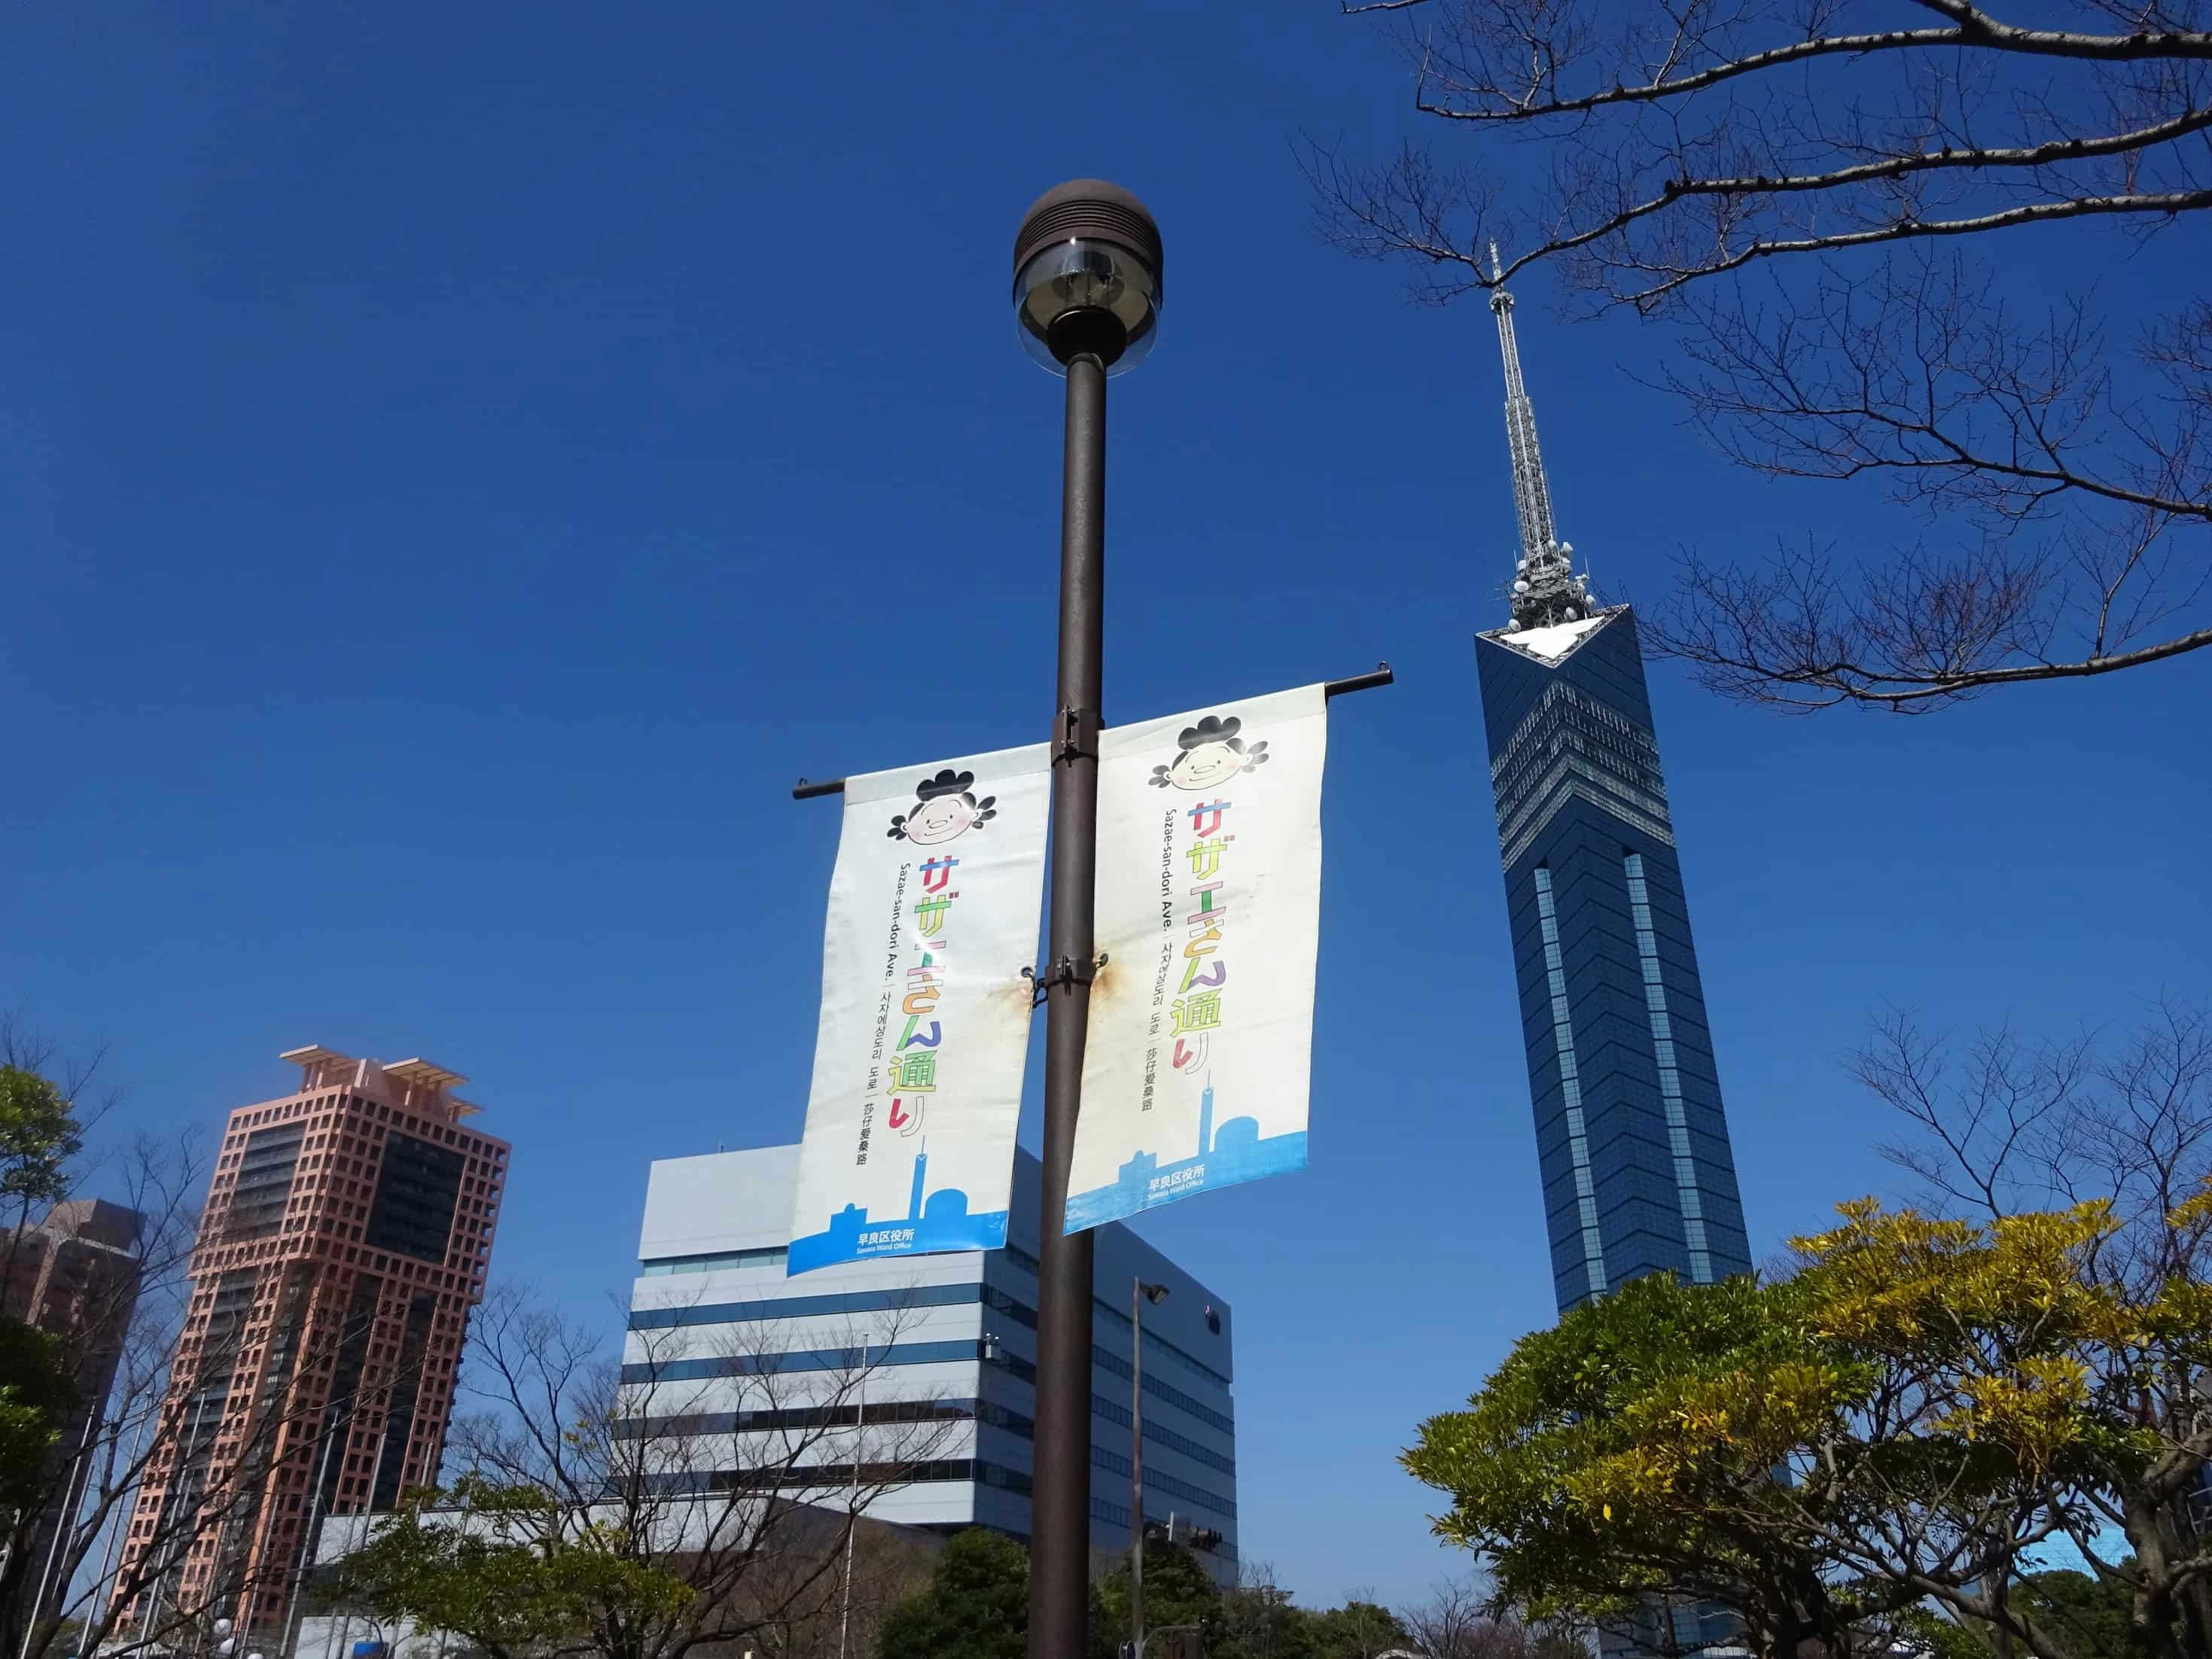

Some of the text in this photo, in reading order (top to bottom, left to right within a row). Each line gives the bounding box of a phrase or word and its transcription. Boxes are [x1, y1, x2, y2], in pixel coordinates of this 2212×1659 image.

[1162, 808, 1177, 932] Sazae-san-dori Ave.
[885, 863, 911, 981] Sazae-san-dori Ave.
[1169, 799, 1235, 1076] サザエさん通り
[1148, 1012, 1162, 1036] 도로
[867, 1066, 879, 1091] 도로
[1149, 1164, 1205, 1192] 早良区役所
[858, 1228, 915, 1247] 早良区役所
[876, 1243, 892, 1251] Ward
